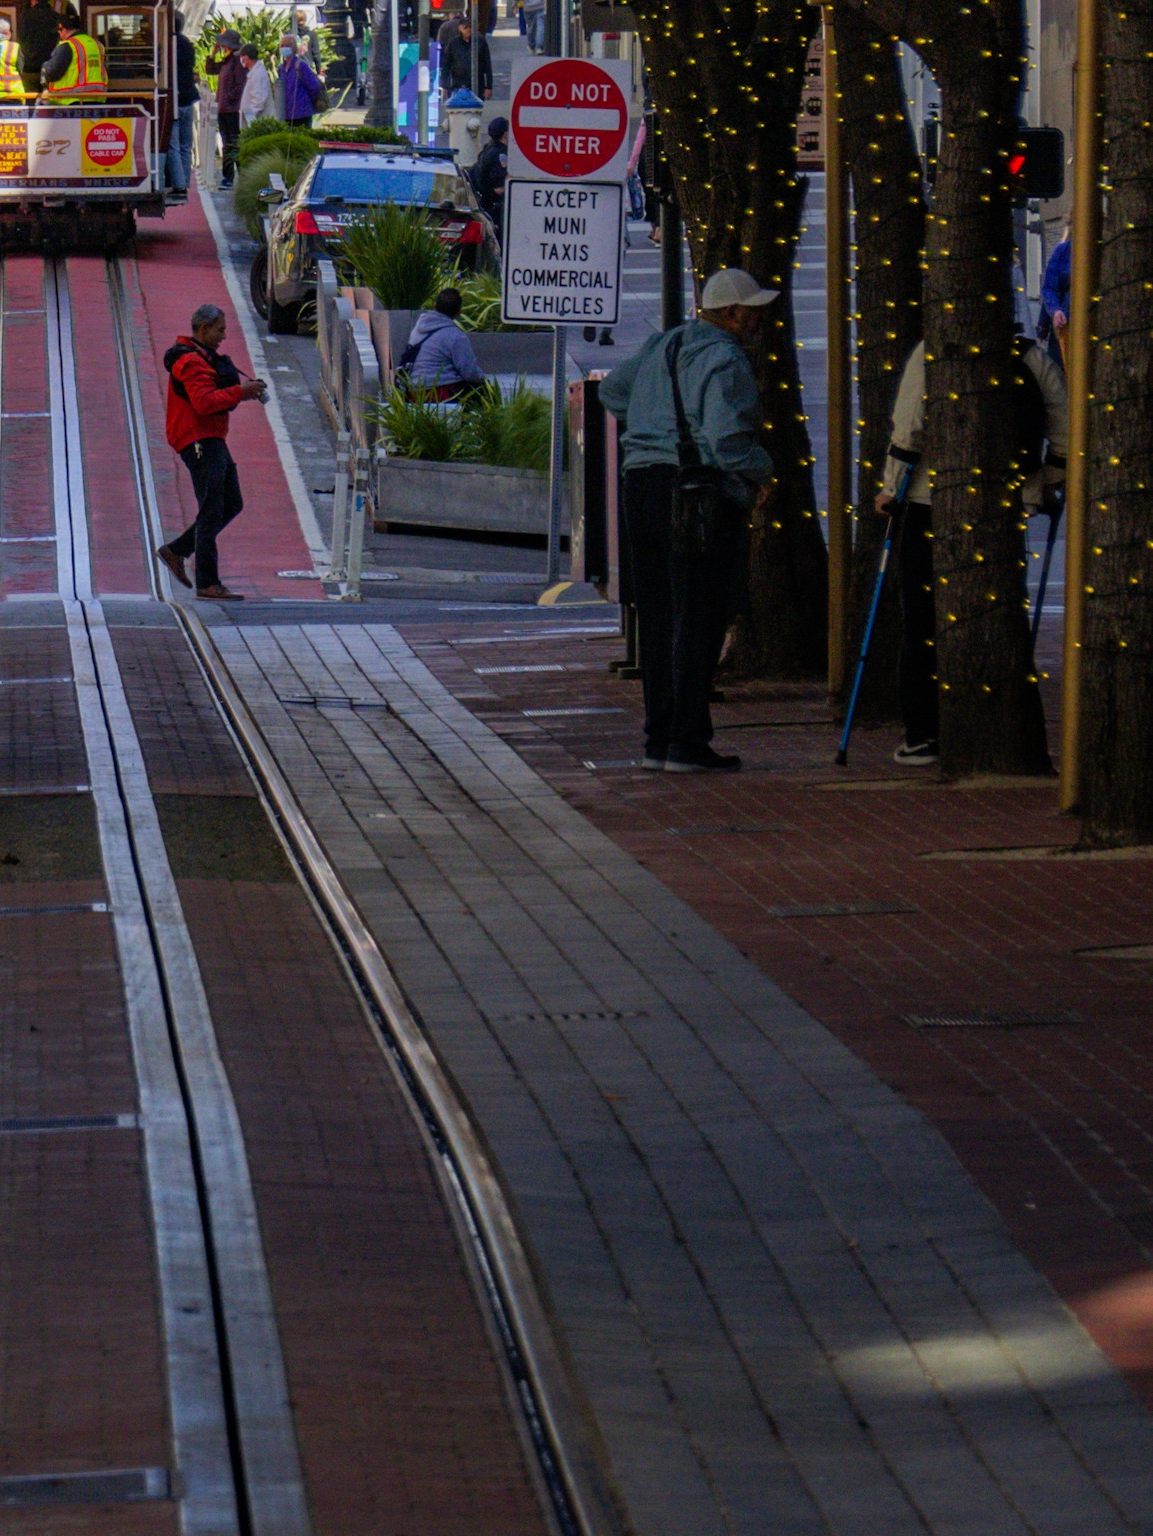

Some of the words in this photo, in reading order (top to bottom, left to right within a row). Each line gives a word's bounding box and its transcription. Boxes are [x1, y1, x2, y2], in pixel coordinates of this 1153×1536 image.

[530, 82, 557, 101] DO
[571, 83, 612, 102] NOT
[54, 109, 110, 118] STREET
[35, 139, 71, 155] 27
[535, 135, 600, 155] ENTER
[83, 178, 131, 187] WHARF
[532, 190, 599, 210] EXCEPT
[543, 217, 587, 236] MUNI
[539, 243, 589, 262] TAXIS
[512, 268, 613, 289] COMMERCIAL
[520, 295, 604, 315] VEHICLES
